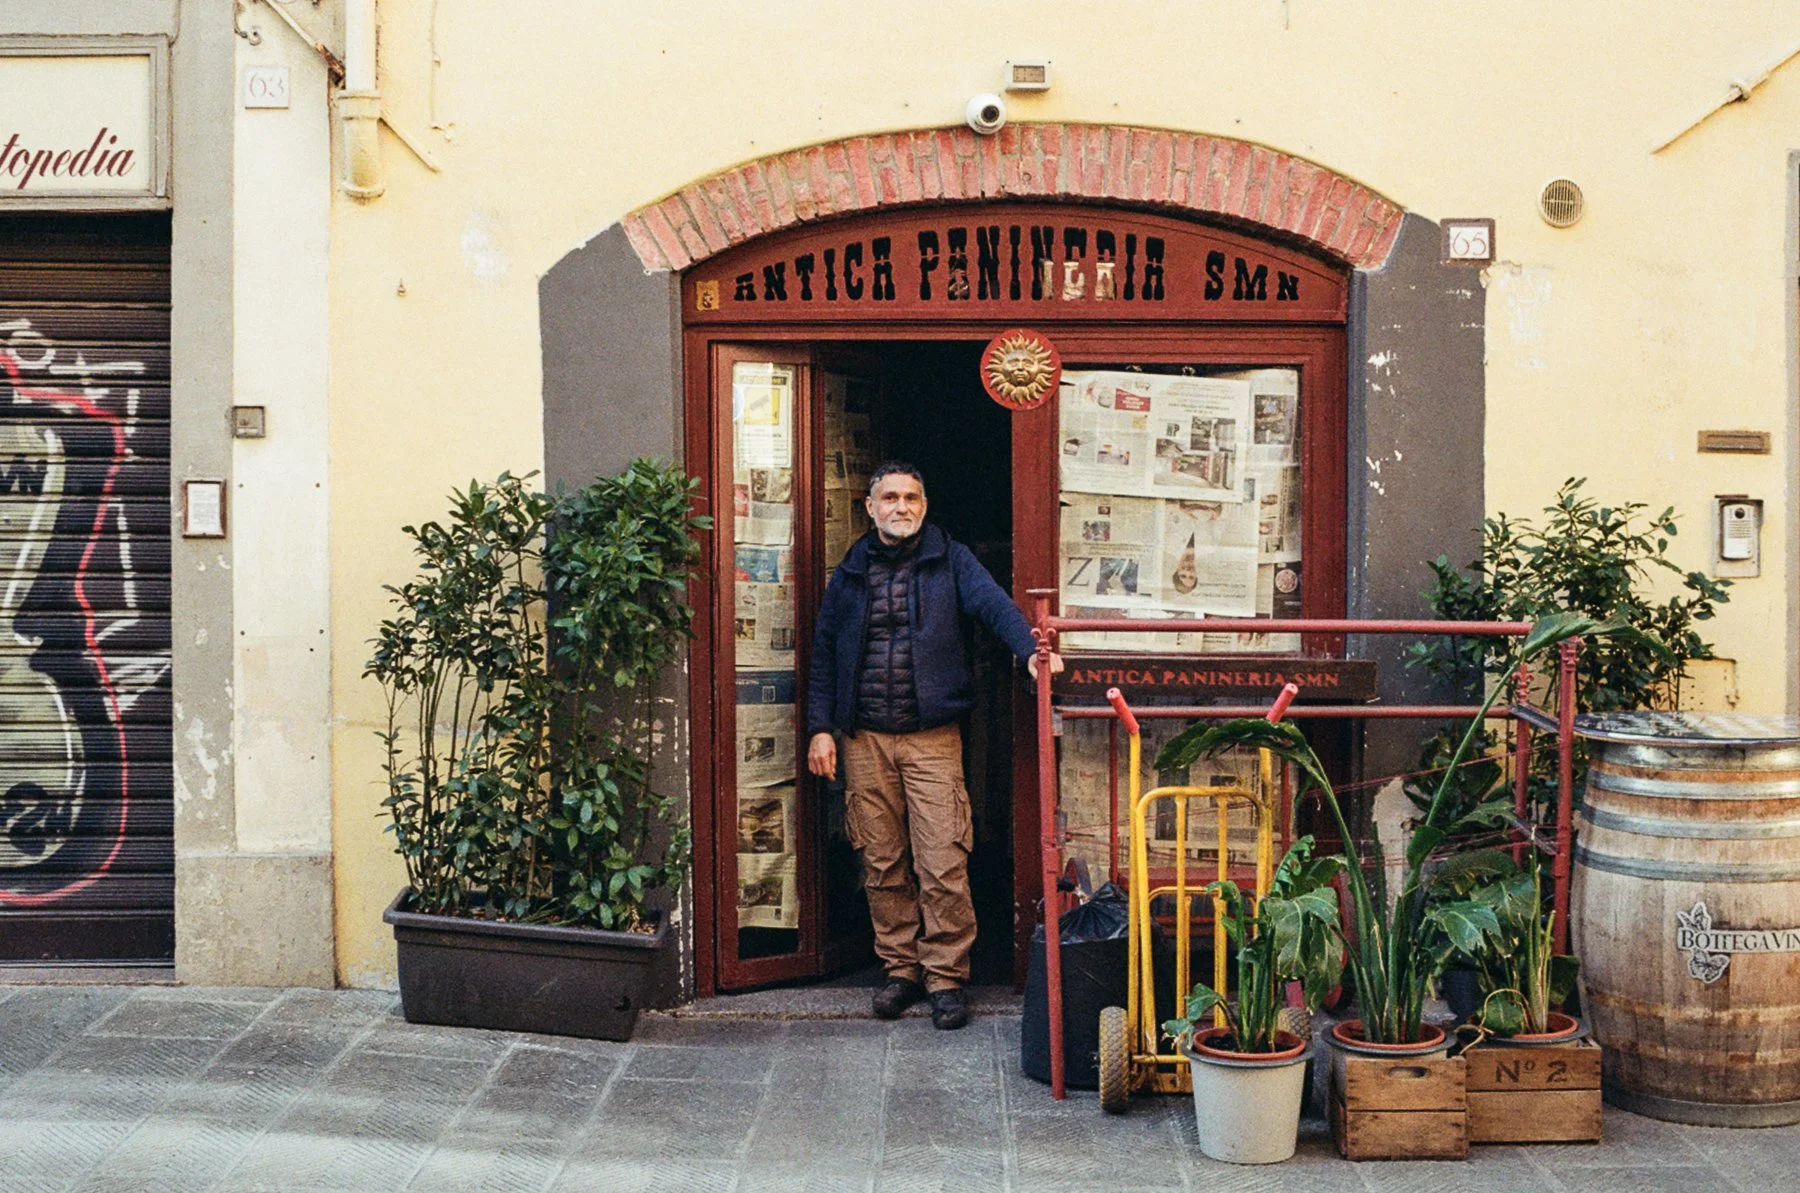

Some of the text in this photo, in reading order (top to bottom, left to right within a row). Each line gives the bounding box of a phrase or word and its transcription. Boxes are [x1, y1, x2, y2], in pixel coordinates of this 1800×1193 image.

[1452, 231, 1487, 257] 65
[734, 225, 1300, 301] ANTICA PANINERIA SMN
[1069, 669, 1340, 688] ANTICA PANINERIA SMN
[1546, 1060, 1568, 1083] 2
